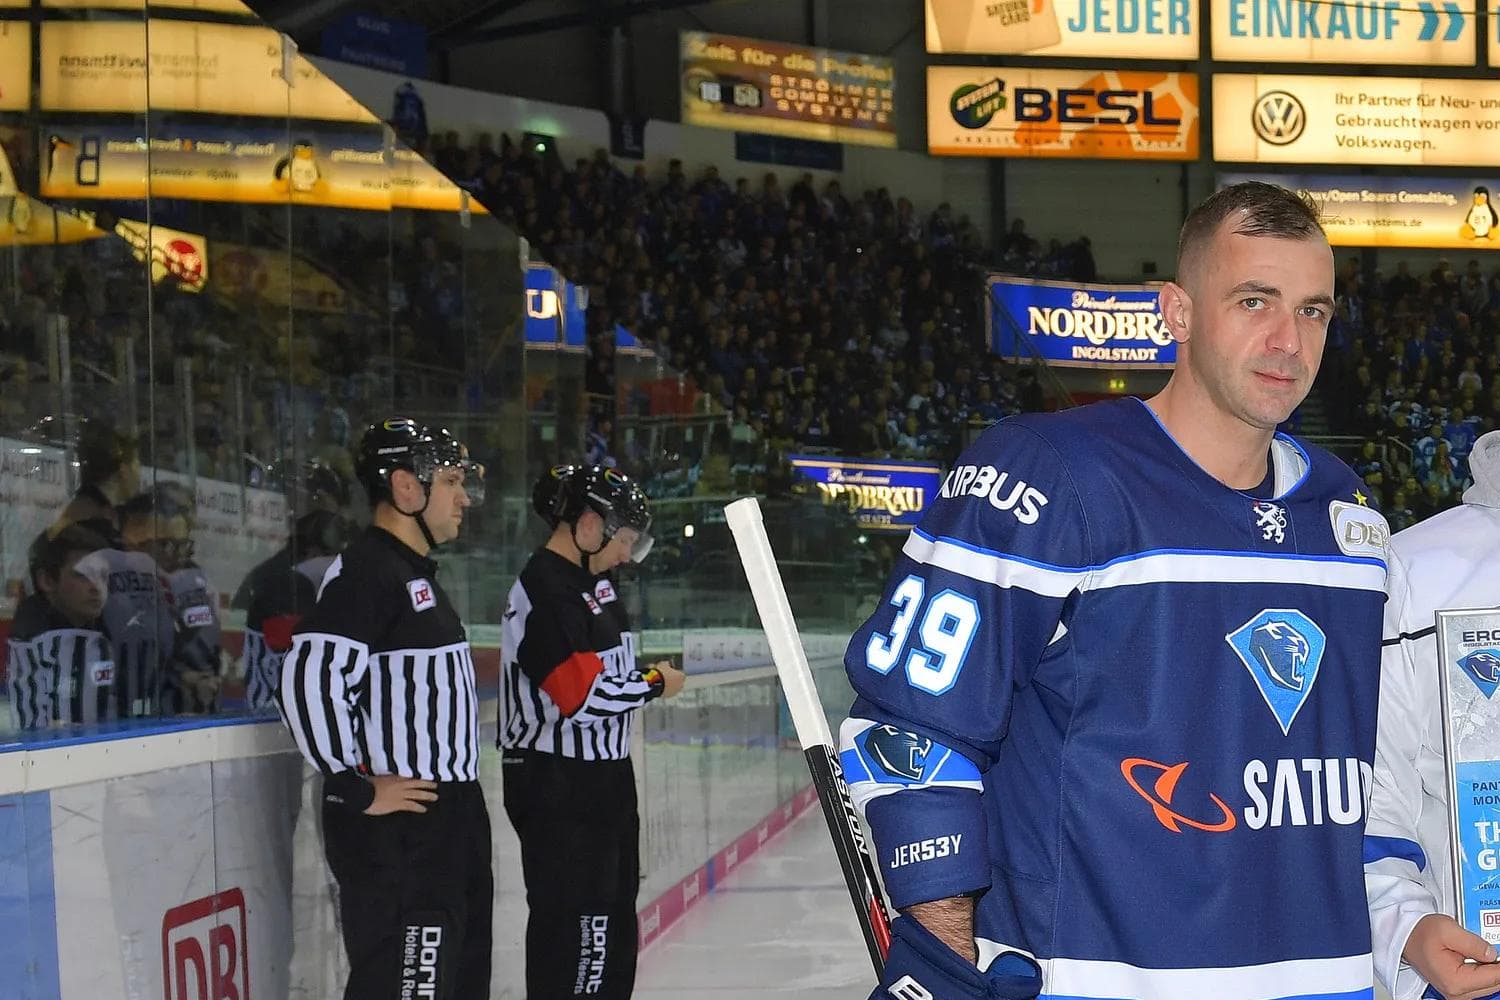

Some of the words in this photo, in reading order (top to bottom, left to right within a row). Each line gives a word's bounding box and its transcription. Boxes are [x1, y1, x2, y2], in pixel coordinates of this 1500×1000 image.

[1067, 0, 1192, 35] JEDER
[1230, 0, 1400, 40] EINKAUF
[1014, 87, 1181, 126] BESL
[1335, 93, 1354, 106] Ihr
[1358, 93, 1413, 108] Partner
[1416, 93, 1437, 109] für
[1440, 94, 1477, 109] Neu-
[1335, 113, 1471, 134] Gebrauchtwagen
[1335, 134, 1437, 153] Volkswagen.
[1071, 345, 1159, 362] INGOLSTADT
[864, 573, 982, 697] 39
[890, 833, 963, 869] JER53Y
[404, 925, 420, 967] Hotels
[586, 915, 609, 996] Dorint
